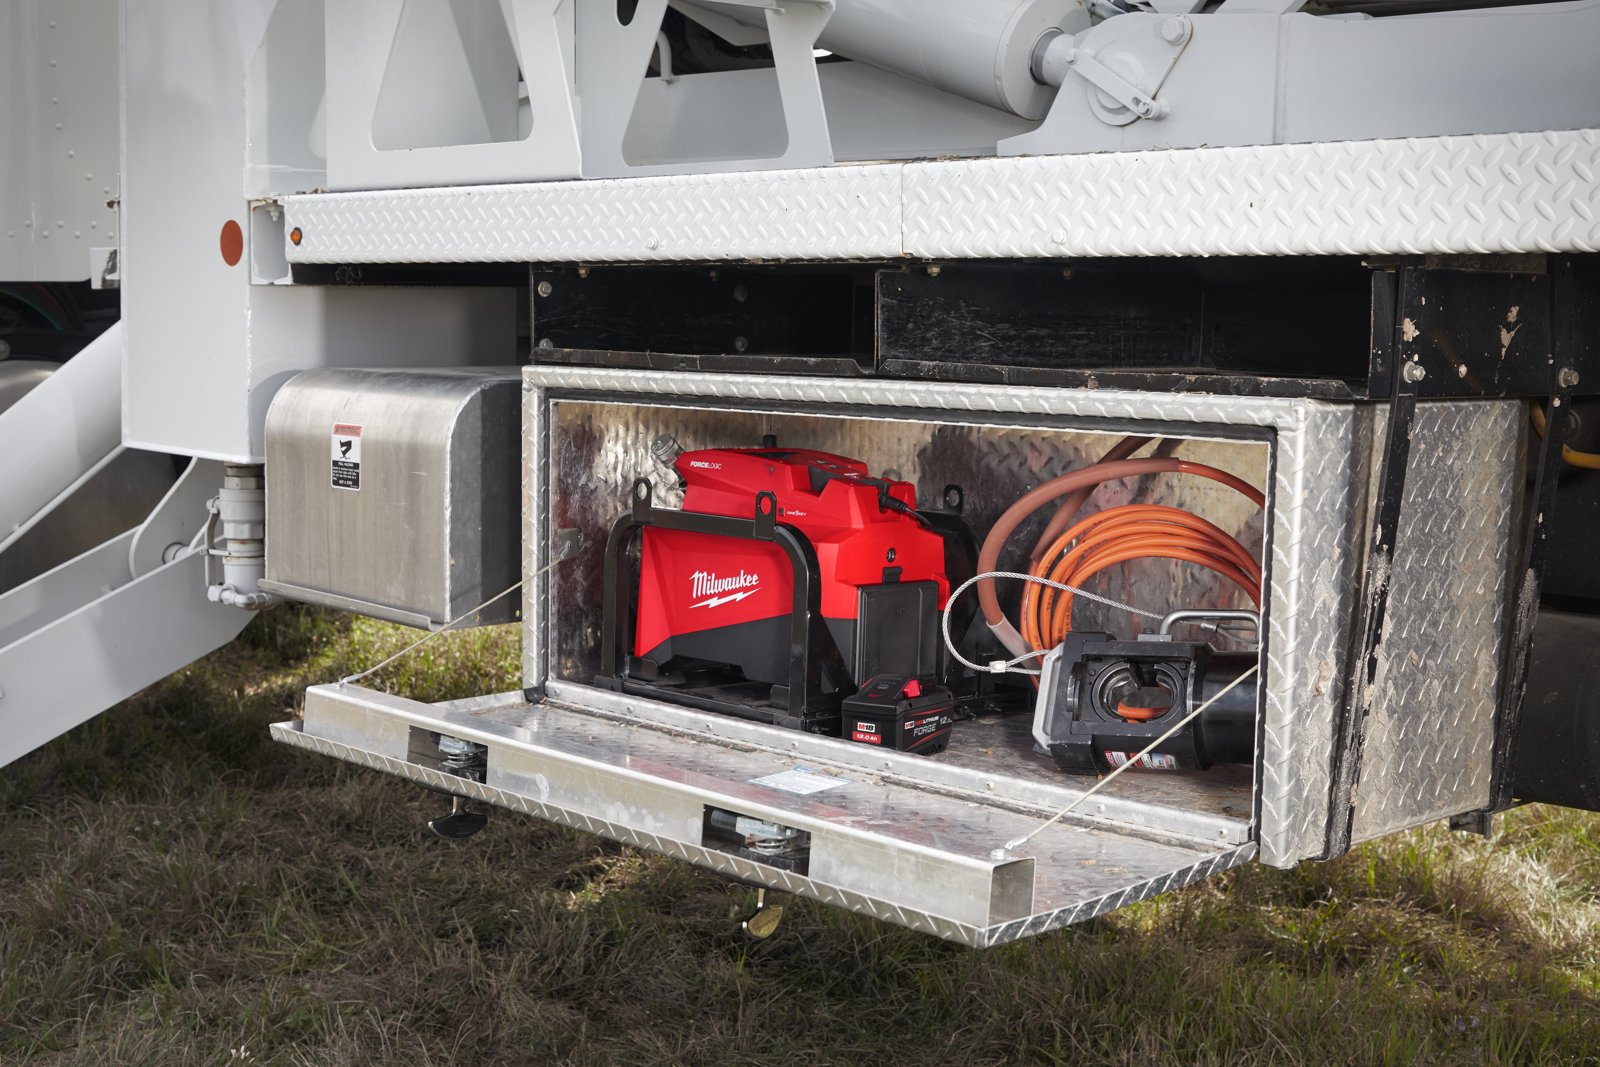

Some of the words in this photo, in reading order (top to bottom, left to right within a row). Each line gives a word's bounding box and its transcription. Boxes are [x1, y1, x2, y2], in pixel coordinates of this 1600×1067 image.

[690, 461, 722, 469] FORCELOGIC
[689, 569, 760, 599] Milwaukee
[858, 723, 874, 731] M18
[914, 723, 937, 737] FORGE
